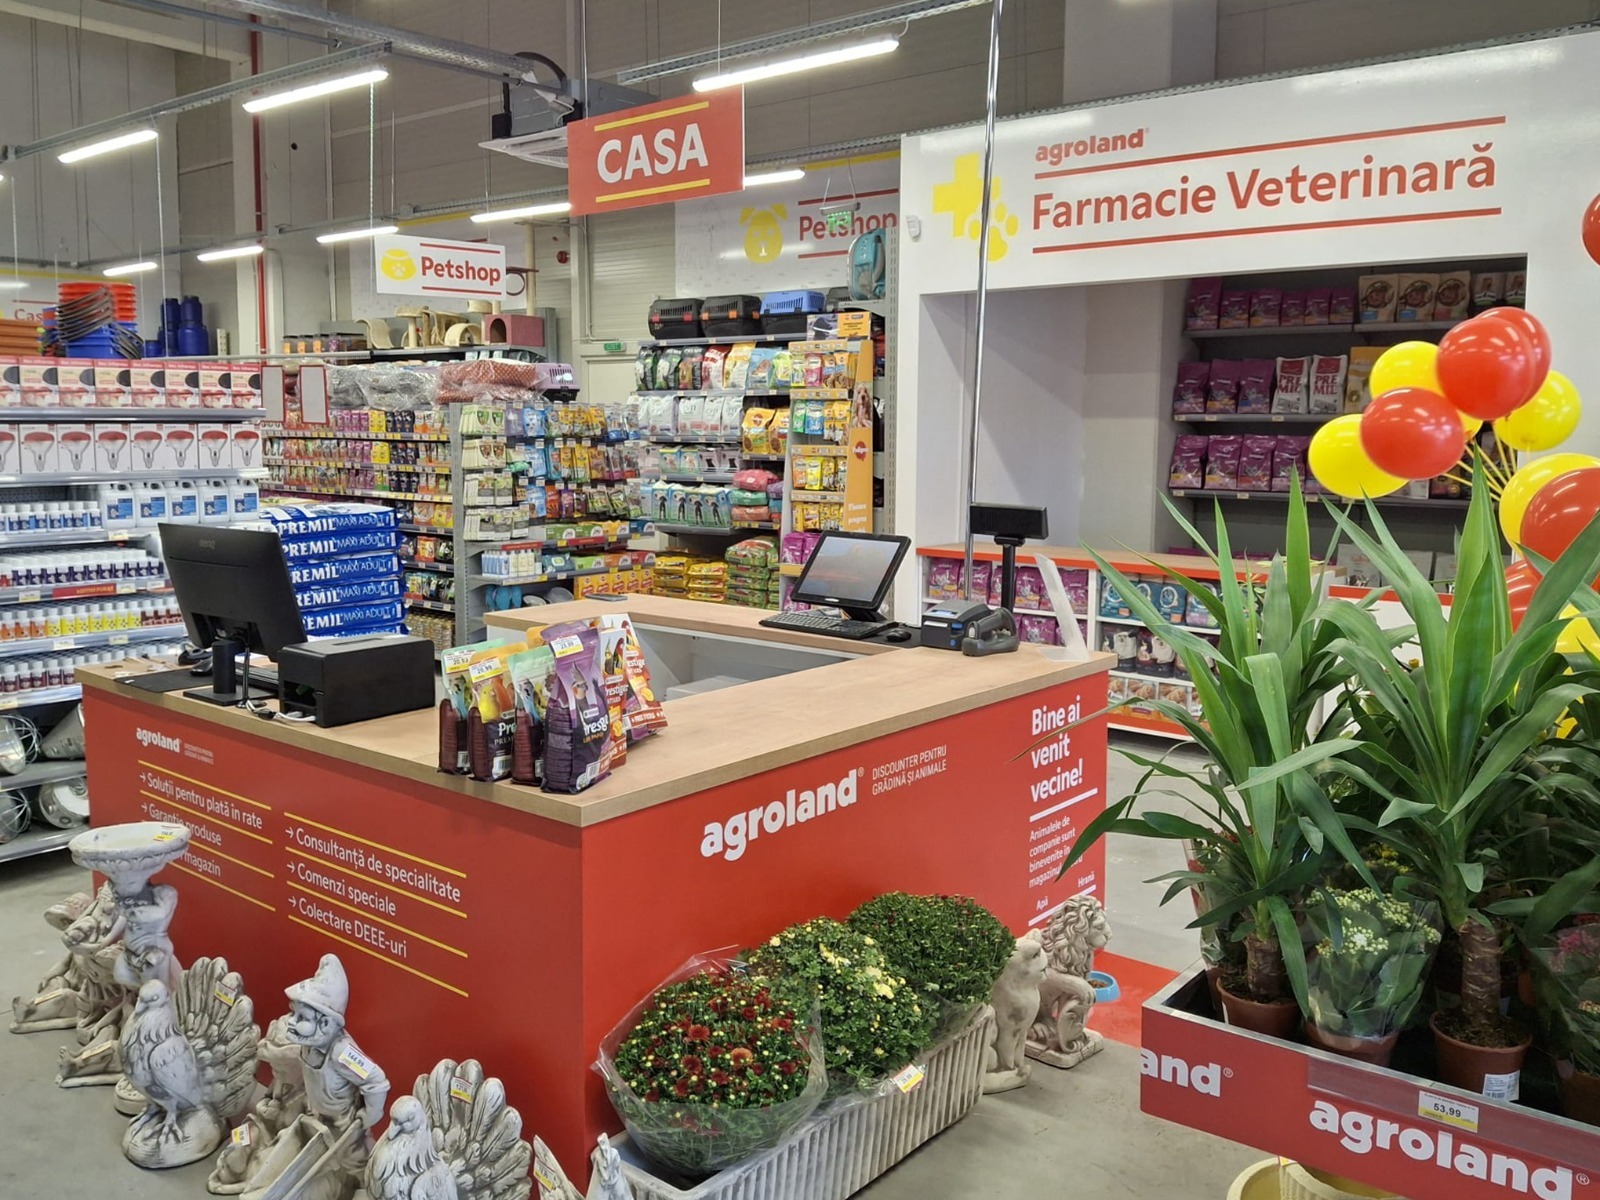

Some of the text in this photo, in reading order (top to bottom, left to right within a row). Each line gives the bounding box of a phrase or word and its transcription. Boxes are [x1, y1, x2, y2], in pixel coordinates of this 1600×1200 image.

[597, 123, 708, 184] CASA
[1033, 142, 1495, 230] Farmacie Veterinară
[421, 256, 500, 286] Petshop
[1313, 384, 1338, 396] MIL
[1315, 374, 1339, 386] PRE
[277, 517, 337, 536] PREMIL
[291, 563, 340, 583] REMIL
[1032, 694, 1081, 736] Bine ai
[136, 727, 180, 753] agroland
[1031, 732, 1071, 769] venit
[872, 744, 947, 780] DISCOUNTER PENTRU
[872, 771, 906, 796] GRĂDINĂ
[915, 759, 947, 781] ANIMALE
[1030, 757, 1083, 803] vecine!
[175, 786, 205, 808] pentru
[206, 796, 230, 818] plată
[242, 811, 263, 829] rate
[1029, 815, 1071, 843] Animalele de
[1029, 826, 1076, 858] companie sunt
[184, 851, 221, 878] magazin
[296, 827, 461, 903] Consultanță de specialitate
[1029, 848, 1063, 873] binevenite
[297, 862, 397, 916] Comenzi speciale
[299, 897, 407, 958] Colectare DEEE-uri
